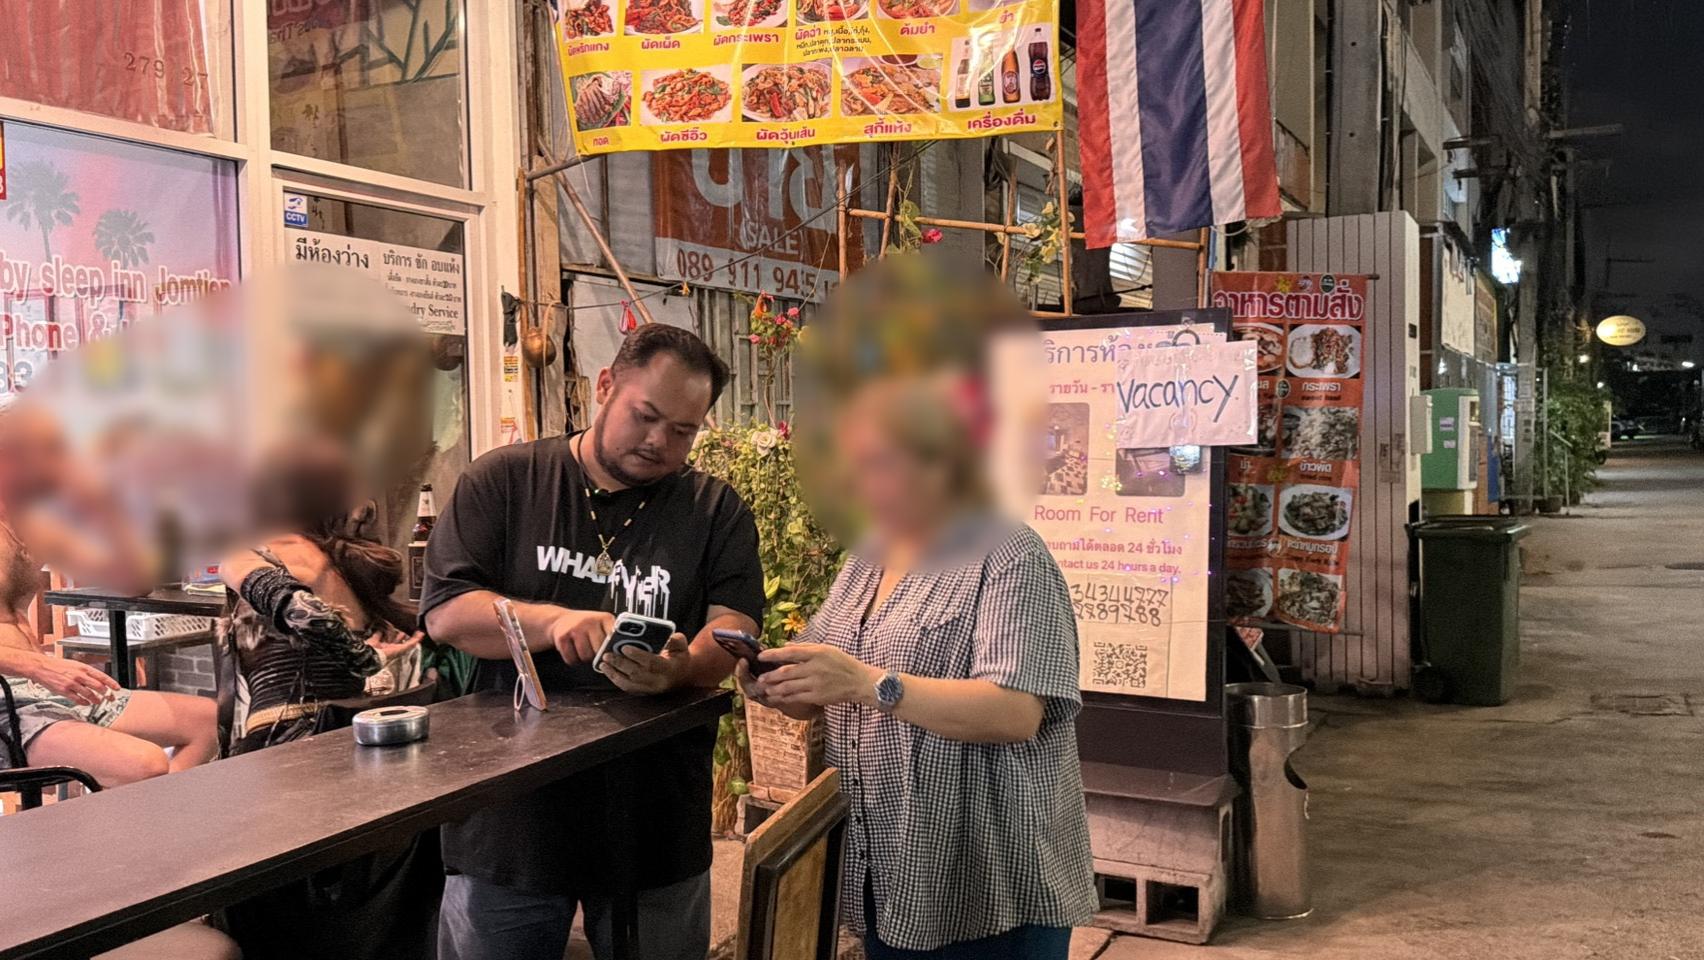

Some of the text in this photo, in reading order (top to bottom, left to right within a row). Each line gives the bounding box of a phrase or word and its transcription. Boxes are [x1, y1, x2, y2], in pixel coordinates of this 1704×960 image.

[899, 23, 935, 36] ต้มยำ
[641, 36, 680, 49] ผัดเผ็ด
[124, 52, 164, 79] 279
[864, 117, 911, 138] สุกี้แห้ง
[967, 109, 1036, 130] เครื่องดื่ม
[756, 126, 815, 144] ผัดวุ้นเส้น
[286, 212, 305, 223] CCTV
[295, 237, 369, 269] มีห้องว่าง
[383, 249, 460, 275] บริการ ซัก อบแห้ง
[677, 248, 713, 282] 089
[728, 258, 760, 289] 911
[40, 255, 105, 308] sleep
[112, 260, 147, 302] inn
[1213, 280, 1364, 320] อาหารตามสั่ง
[428, 303, 459, 319] Service
[1034, 504, 1164, 524] Room For Rent
[1128, 543, 1143, 553] 24
[1146, 538, 1182, 555] ชั่วโมง
[1086, 561, 1099, 569] us
[1101, 560, 1115, 570] 24
[1118, 561, 1147, 572] hours
[1150, 564, 1157, 572] a
[1159, 562, 1181, 576] day.
